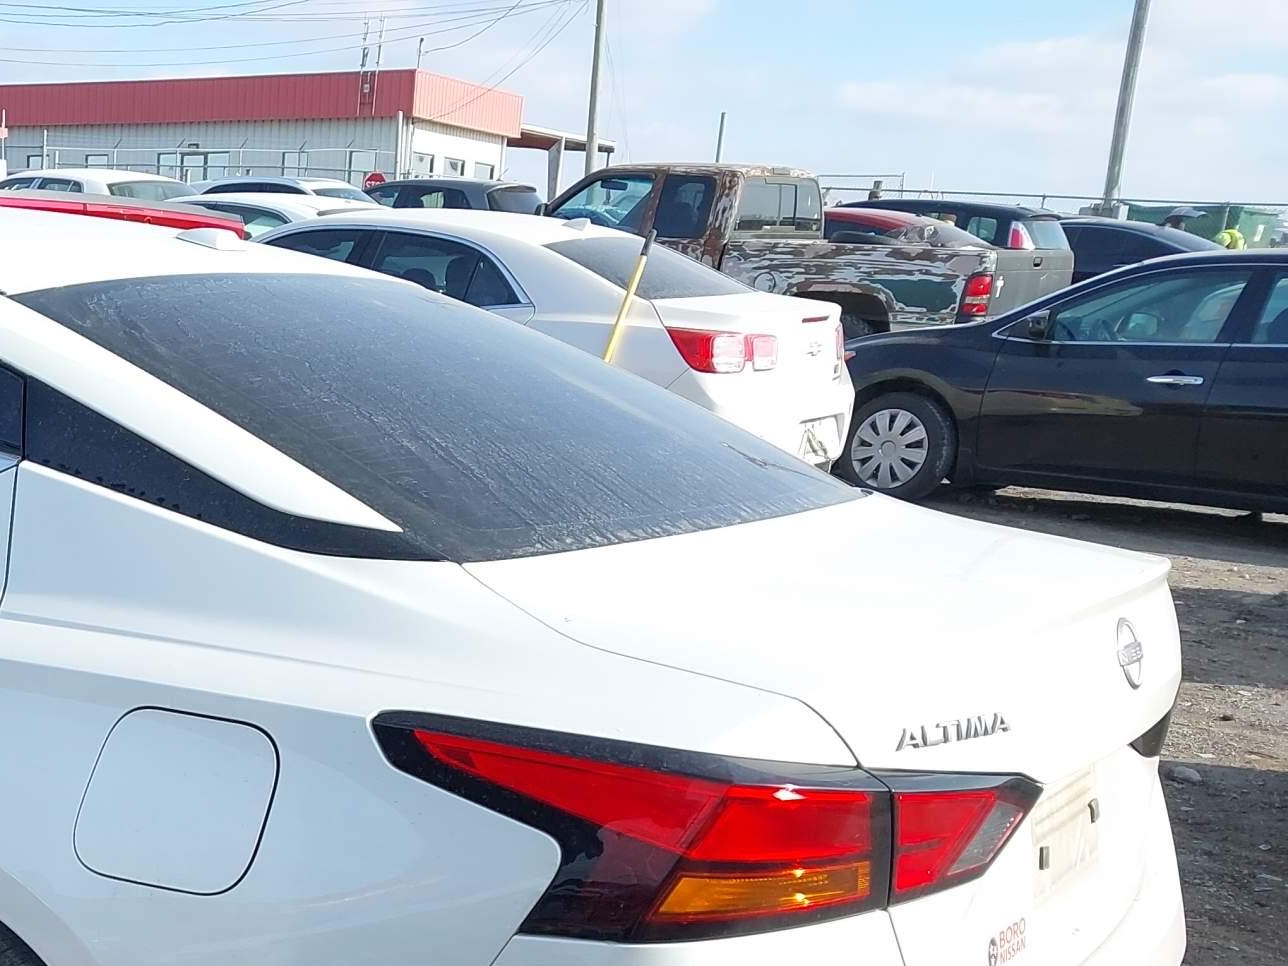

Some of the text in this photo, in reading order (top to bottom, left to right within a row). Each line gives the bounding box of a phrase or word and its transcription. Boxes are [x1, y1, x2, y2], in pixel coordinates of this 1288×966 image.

[895, 712, 1011, 752] ALTIMA
[999, 917, 1026, 949] BORO
[999, 936, 1026, 965] NISSAN
